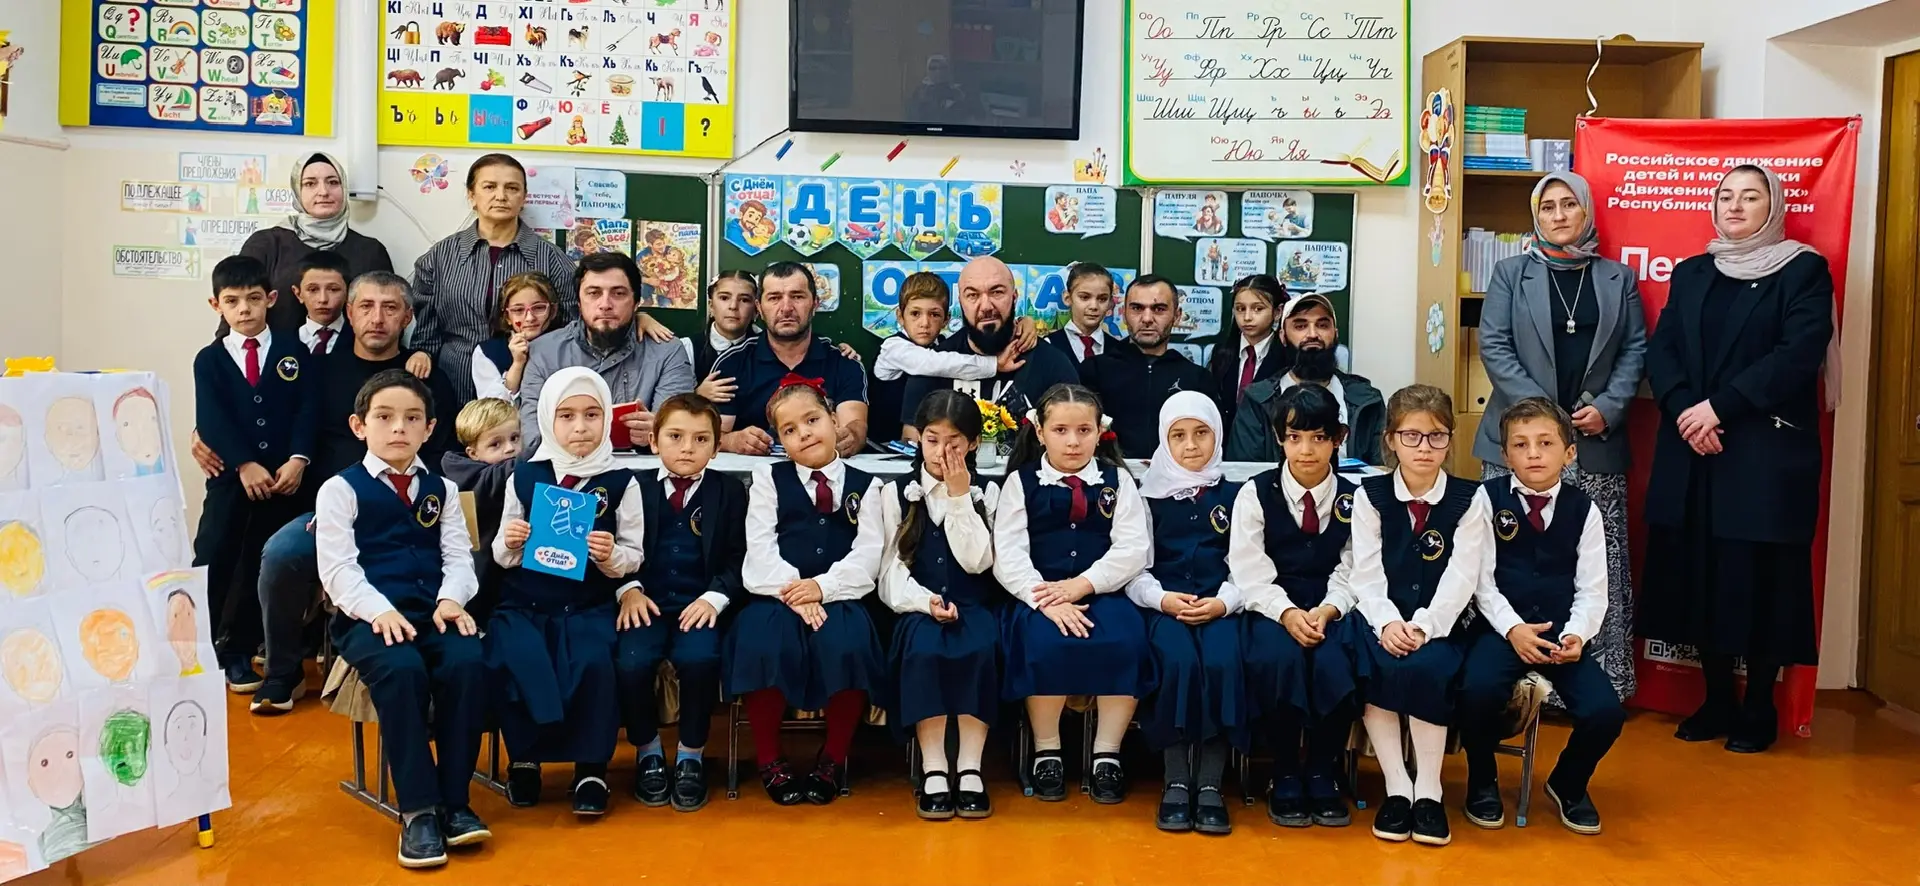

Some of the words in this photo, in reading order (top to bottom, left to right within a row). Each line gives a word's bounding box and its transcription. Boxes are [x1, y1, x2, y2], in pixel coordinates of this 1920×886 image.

[433, 2, 443, 17] Ц
[476, 5, 487, 19] Д
[647, 12, 655, 24] Ч
[689, 14, 699, 26] Я
[1186, 12, 1199, 20] Пп
[1247, 12, 1260, 21] Рр
[431, 51, 440, 62] П
[517, 99, 528, 110] Ф
[559, 101, 573, 113] Ю
[602, 100, 610, 114] Ё
[1606, 153, 1720, 167] Российское
[1722, 157, 1824, 168] движение
[183, 166, 236, 179] ПРЕДЛОЖЕНИЯ
[1624, 168, 1680, 182] детей
[1683, 171, 1695, 181] и
[588, 180, 618, 188] Спасибо
[743, 178, 775, 191] Днём
[124, 184, 182, 199] ПОДЛЕЖАЩЕЕ
[265, 188, 295, 202] СКАЗУ
[597, 218, 629, 230] Папа
[1304, 244, 1342, 252] ПАПОЧКА
[115, 249, 183, 264] ОБСТОЯТЕЛЬСТВО
